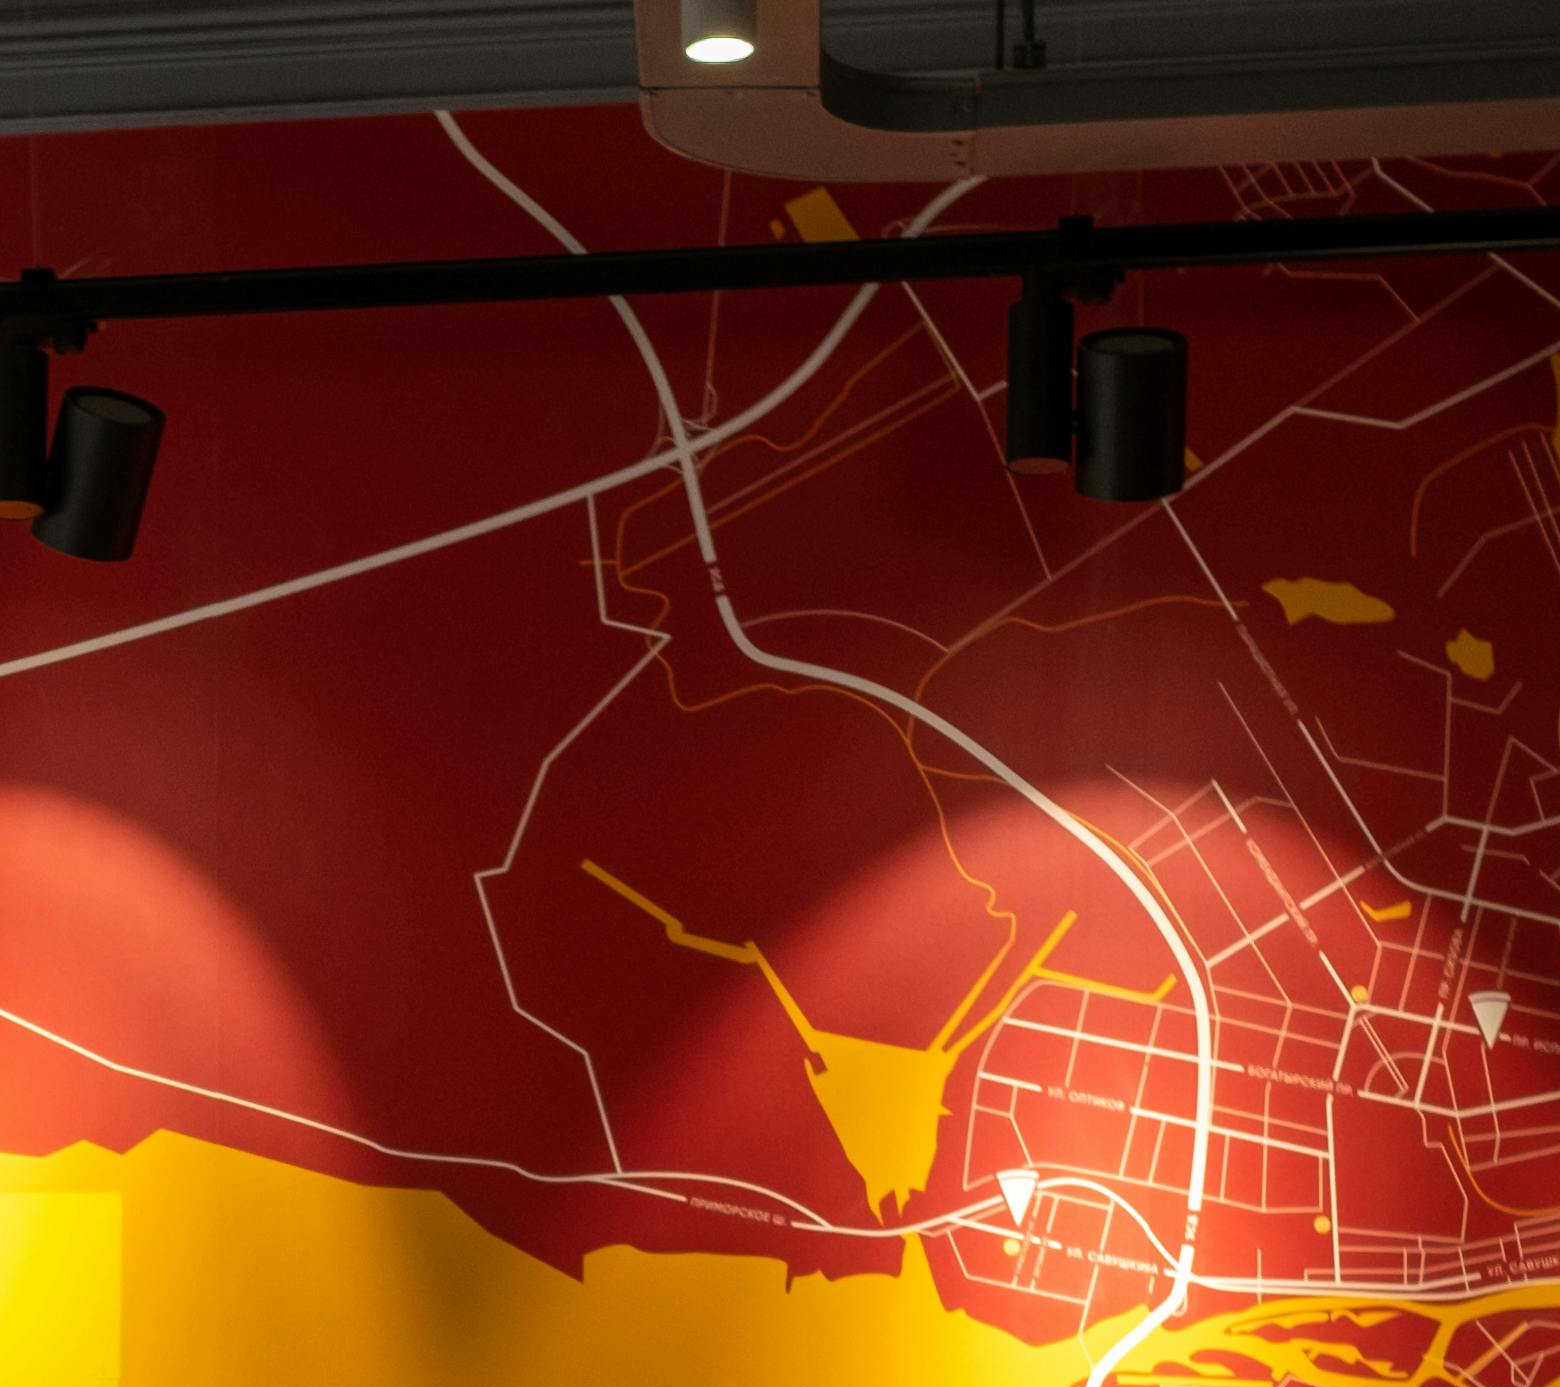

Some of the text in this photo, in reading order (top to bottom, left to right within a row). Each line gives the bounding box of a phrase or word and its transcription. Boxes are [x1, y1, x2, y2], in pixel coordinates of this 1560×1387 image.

[1245, 1063, 1335, 1092] БОГАТЫРСКИЙ
[1066, 1088, 1127, 1114] ОПТИКОВ
[688, 1195, 771, 1223] ПРИМОРСКОЕ
[1485, 1262, 1508, 1280] УЛ.
